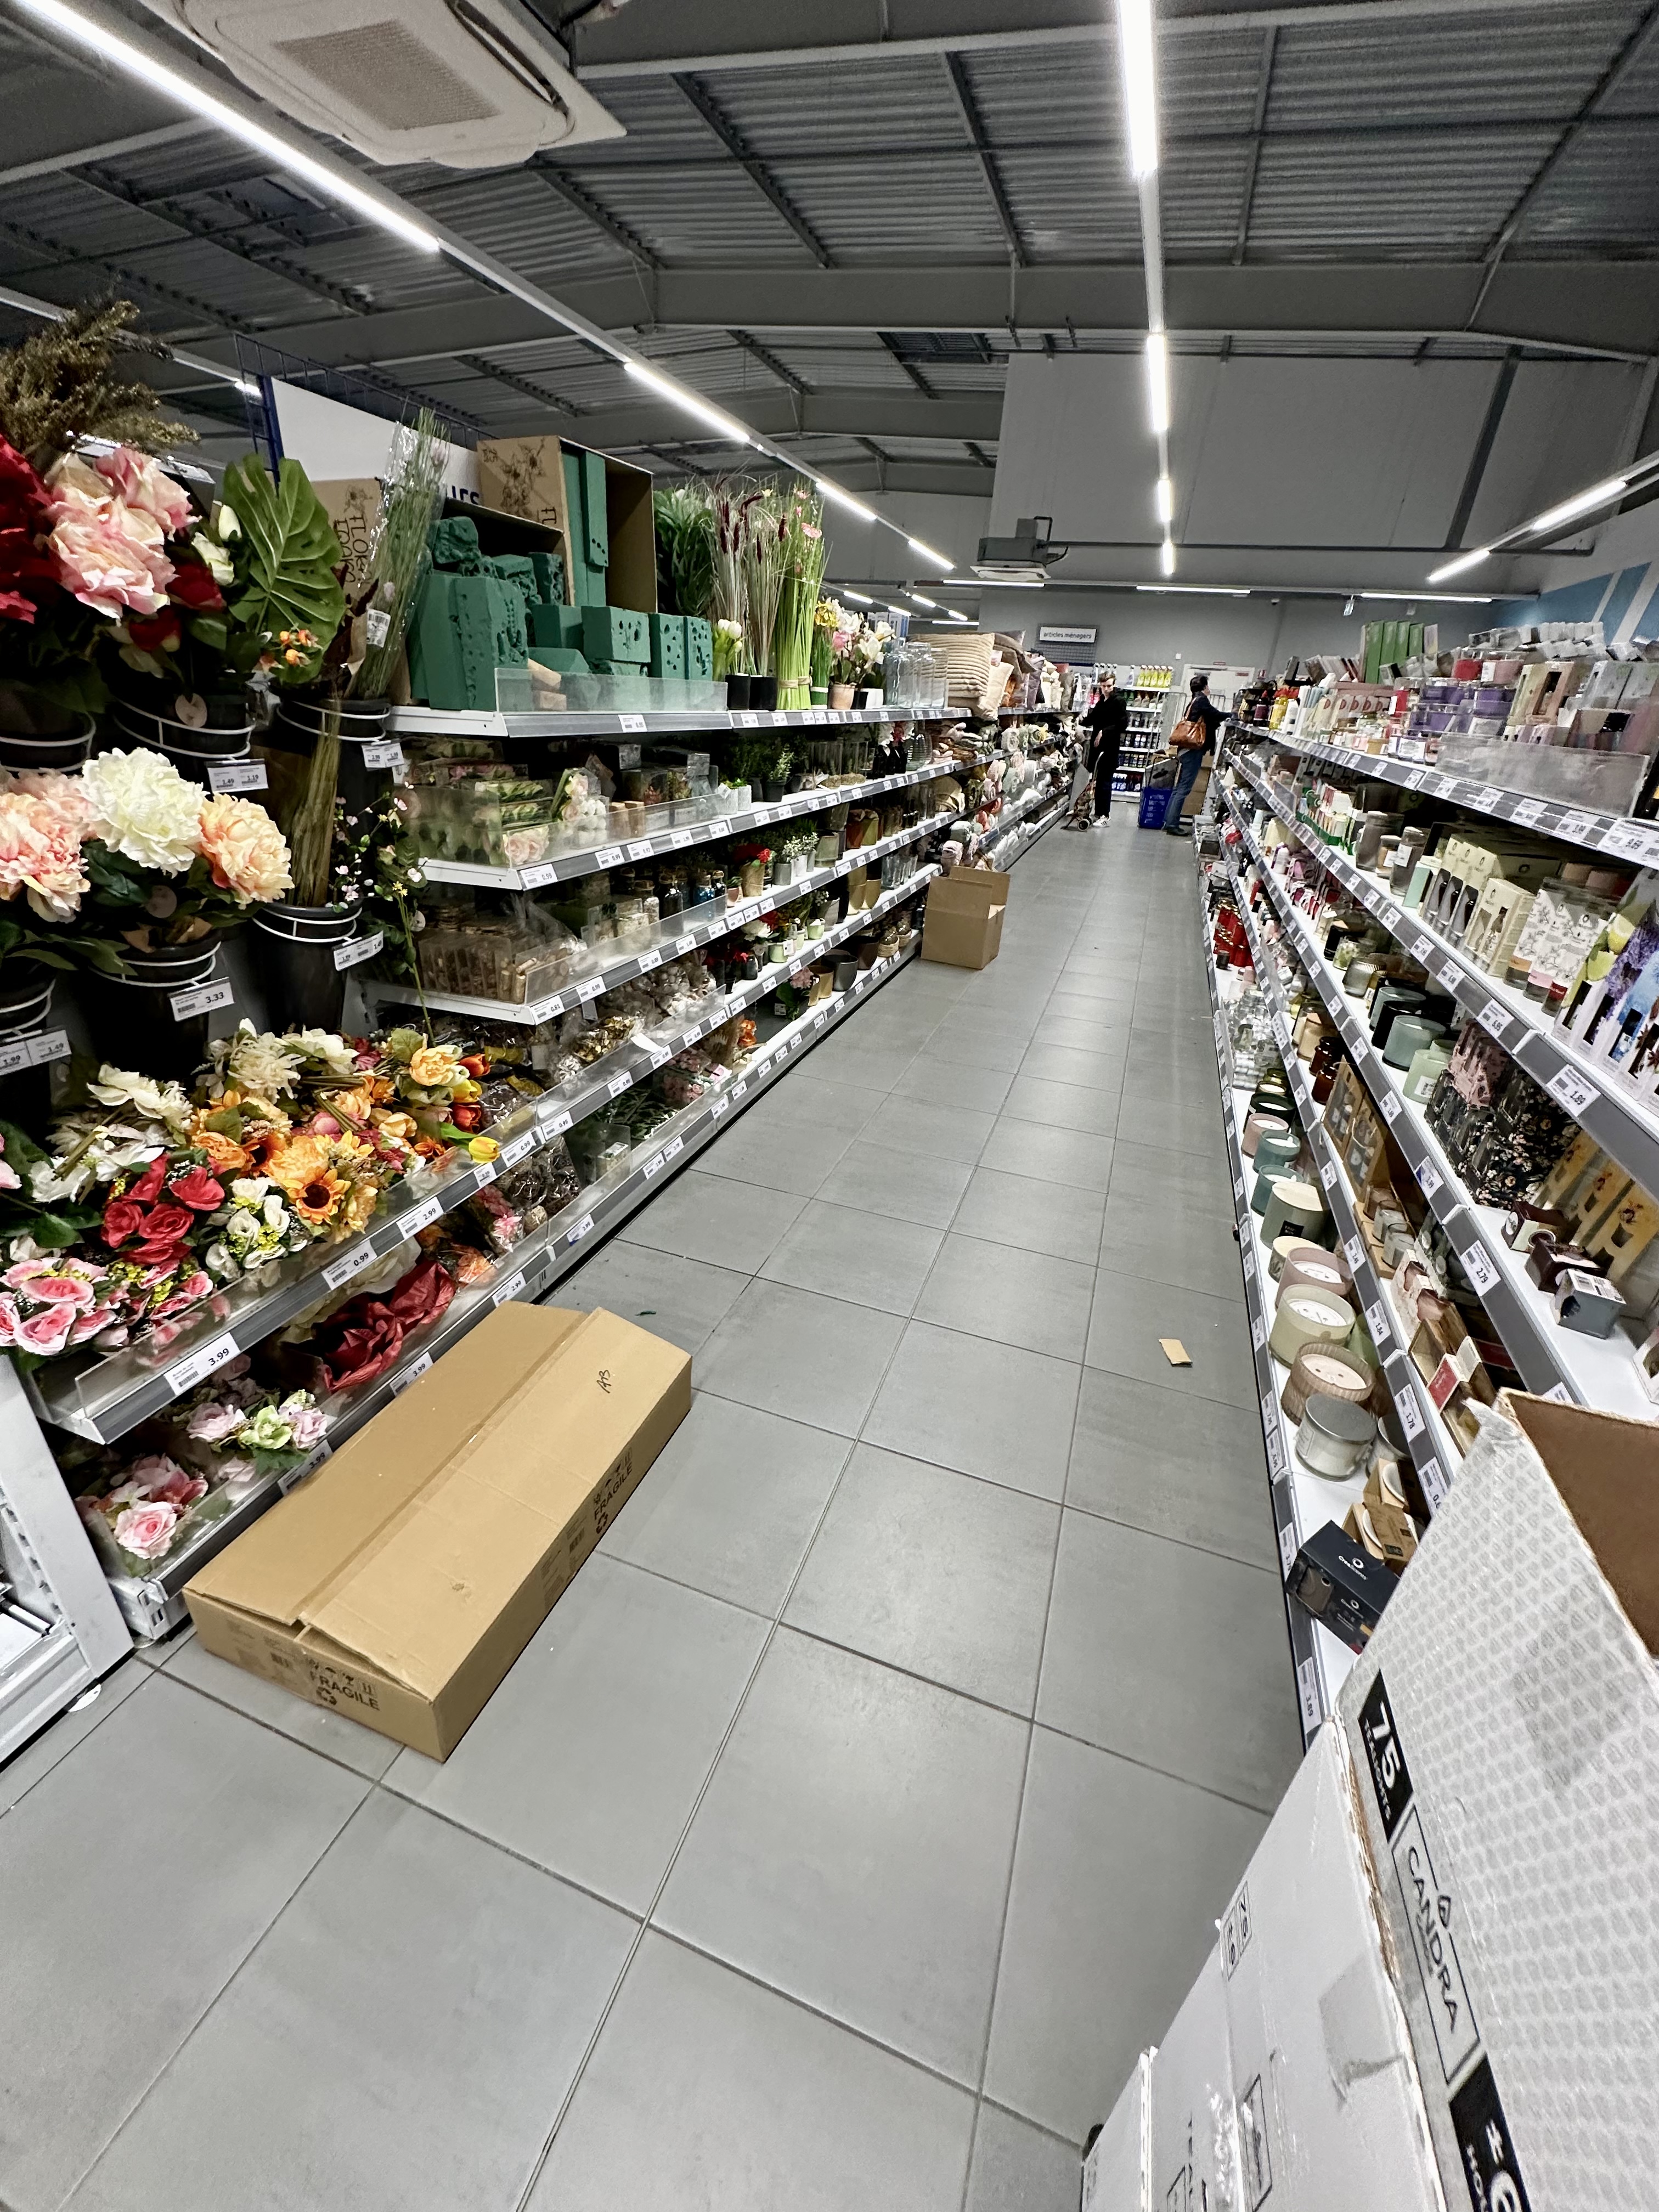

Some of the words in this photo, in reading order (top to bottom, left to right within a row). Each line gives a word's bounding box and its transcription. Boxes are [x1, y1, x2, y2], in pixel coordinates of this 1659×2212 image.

[612, 854, 621, 862] 0.99
[206, 992, 224, 1004] 3.33
[3, 1054, 21, 1065] 1.99
[520, 1140, 531, 1151] 0.99
[422, 1207, 437, 1221] 2.99
[353, 1252, 369, 1267] 0.99
[1475, 1267, 1488, 1284] 2.79
[511, 1280, 522, 1292] 2.99
[208, 1347, 229, 1366] 3.99
[413, 1363, 426, 1378] 3.99
[309, 1452, 326, 1470] 3.99
[594, 1462, 633, 1521] FRAGILE
[310, 1671, 380, 1712] FRAGILE
[1372, 1700, 1401, 1790] 75
[1409, 1846, 1458, 2034] CANDRA
